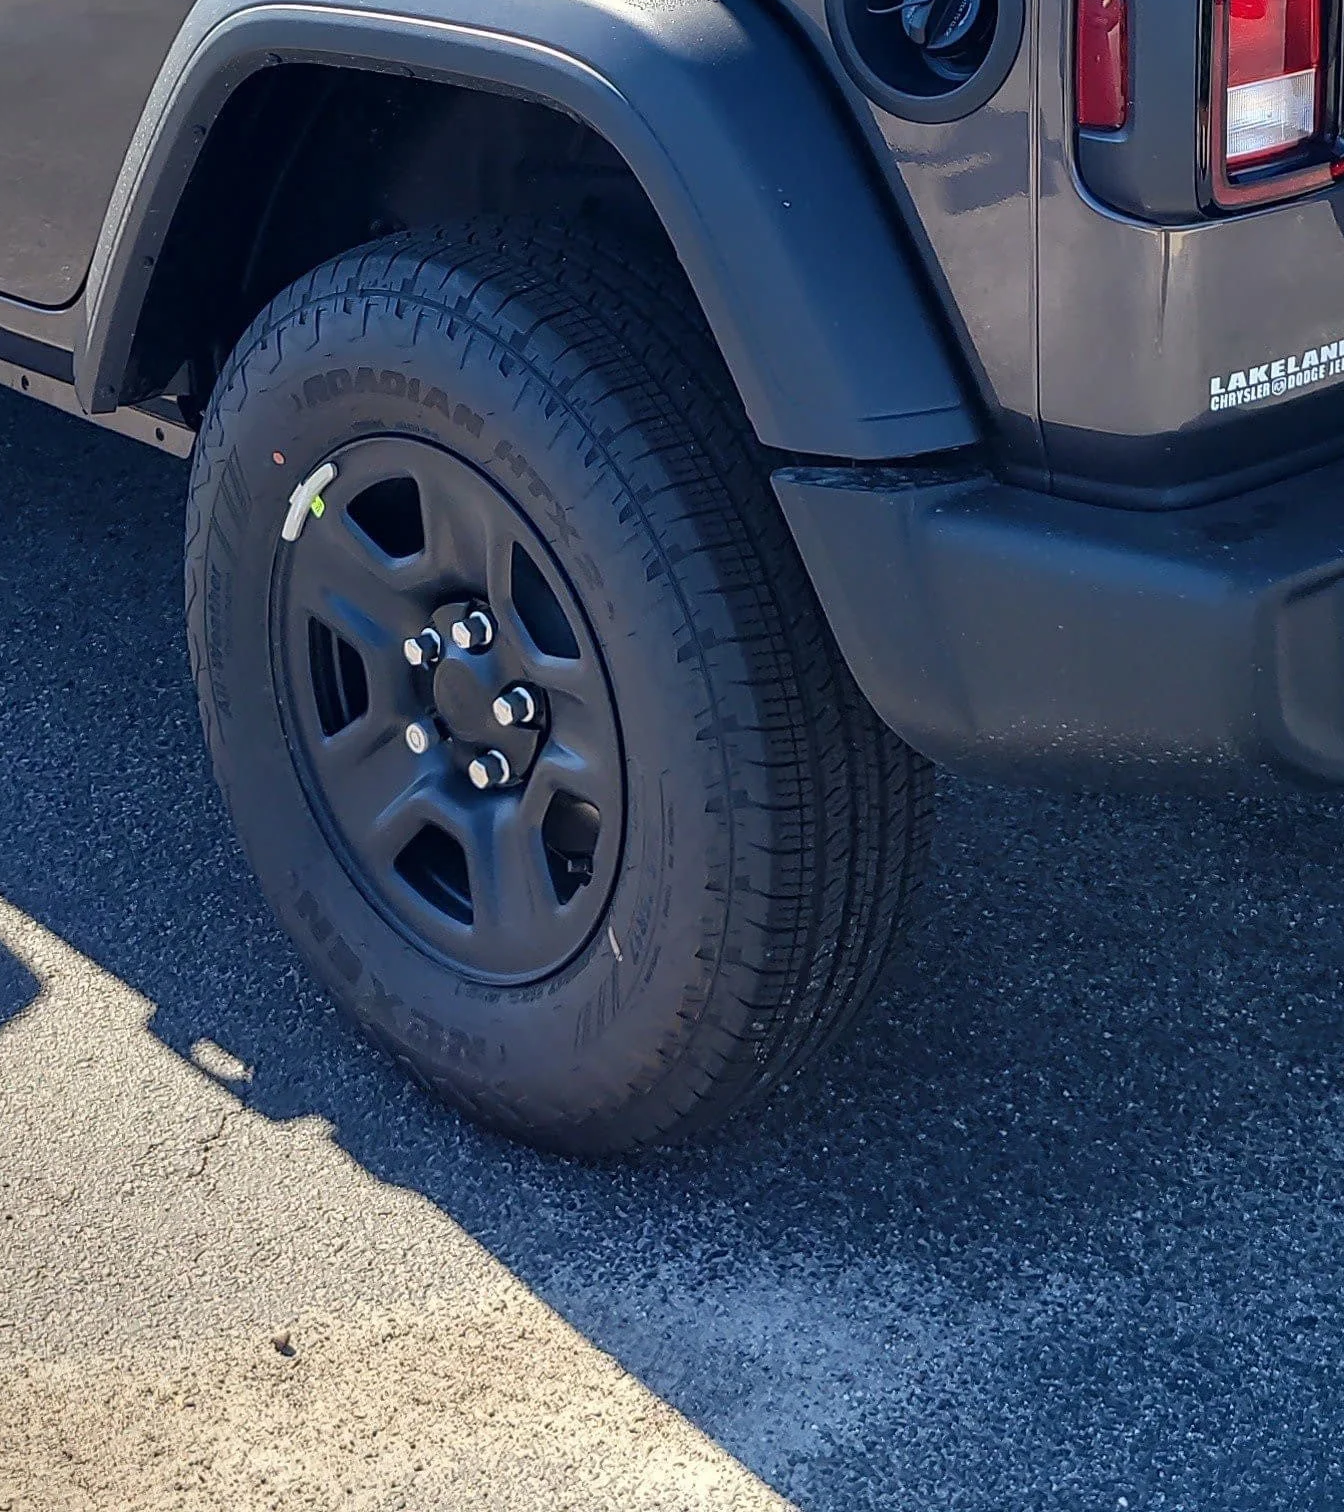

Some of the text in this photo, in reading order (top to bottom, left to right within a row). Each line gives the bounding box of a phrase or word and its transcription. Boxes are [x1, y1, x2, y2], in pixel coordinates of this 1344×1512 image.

[303, 366, 485, 439] ROADIAN
[1210, 382, 1271, 412] CHRYSLER
[1287, 364, 1326, 390] DODGE
